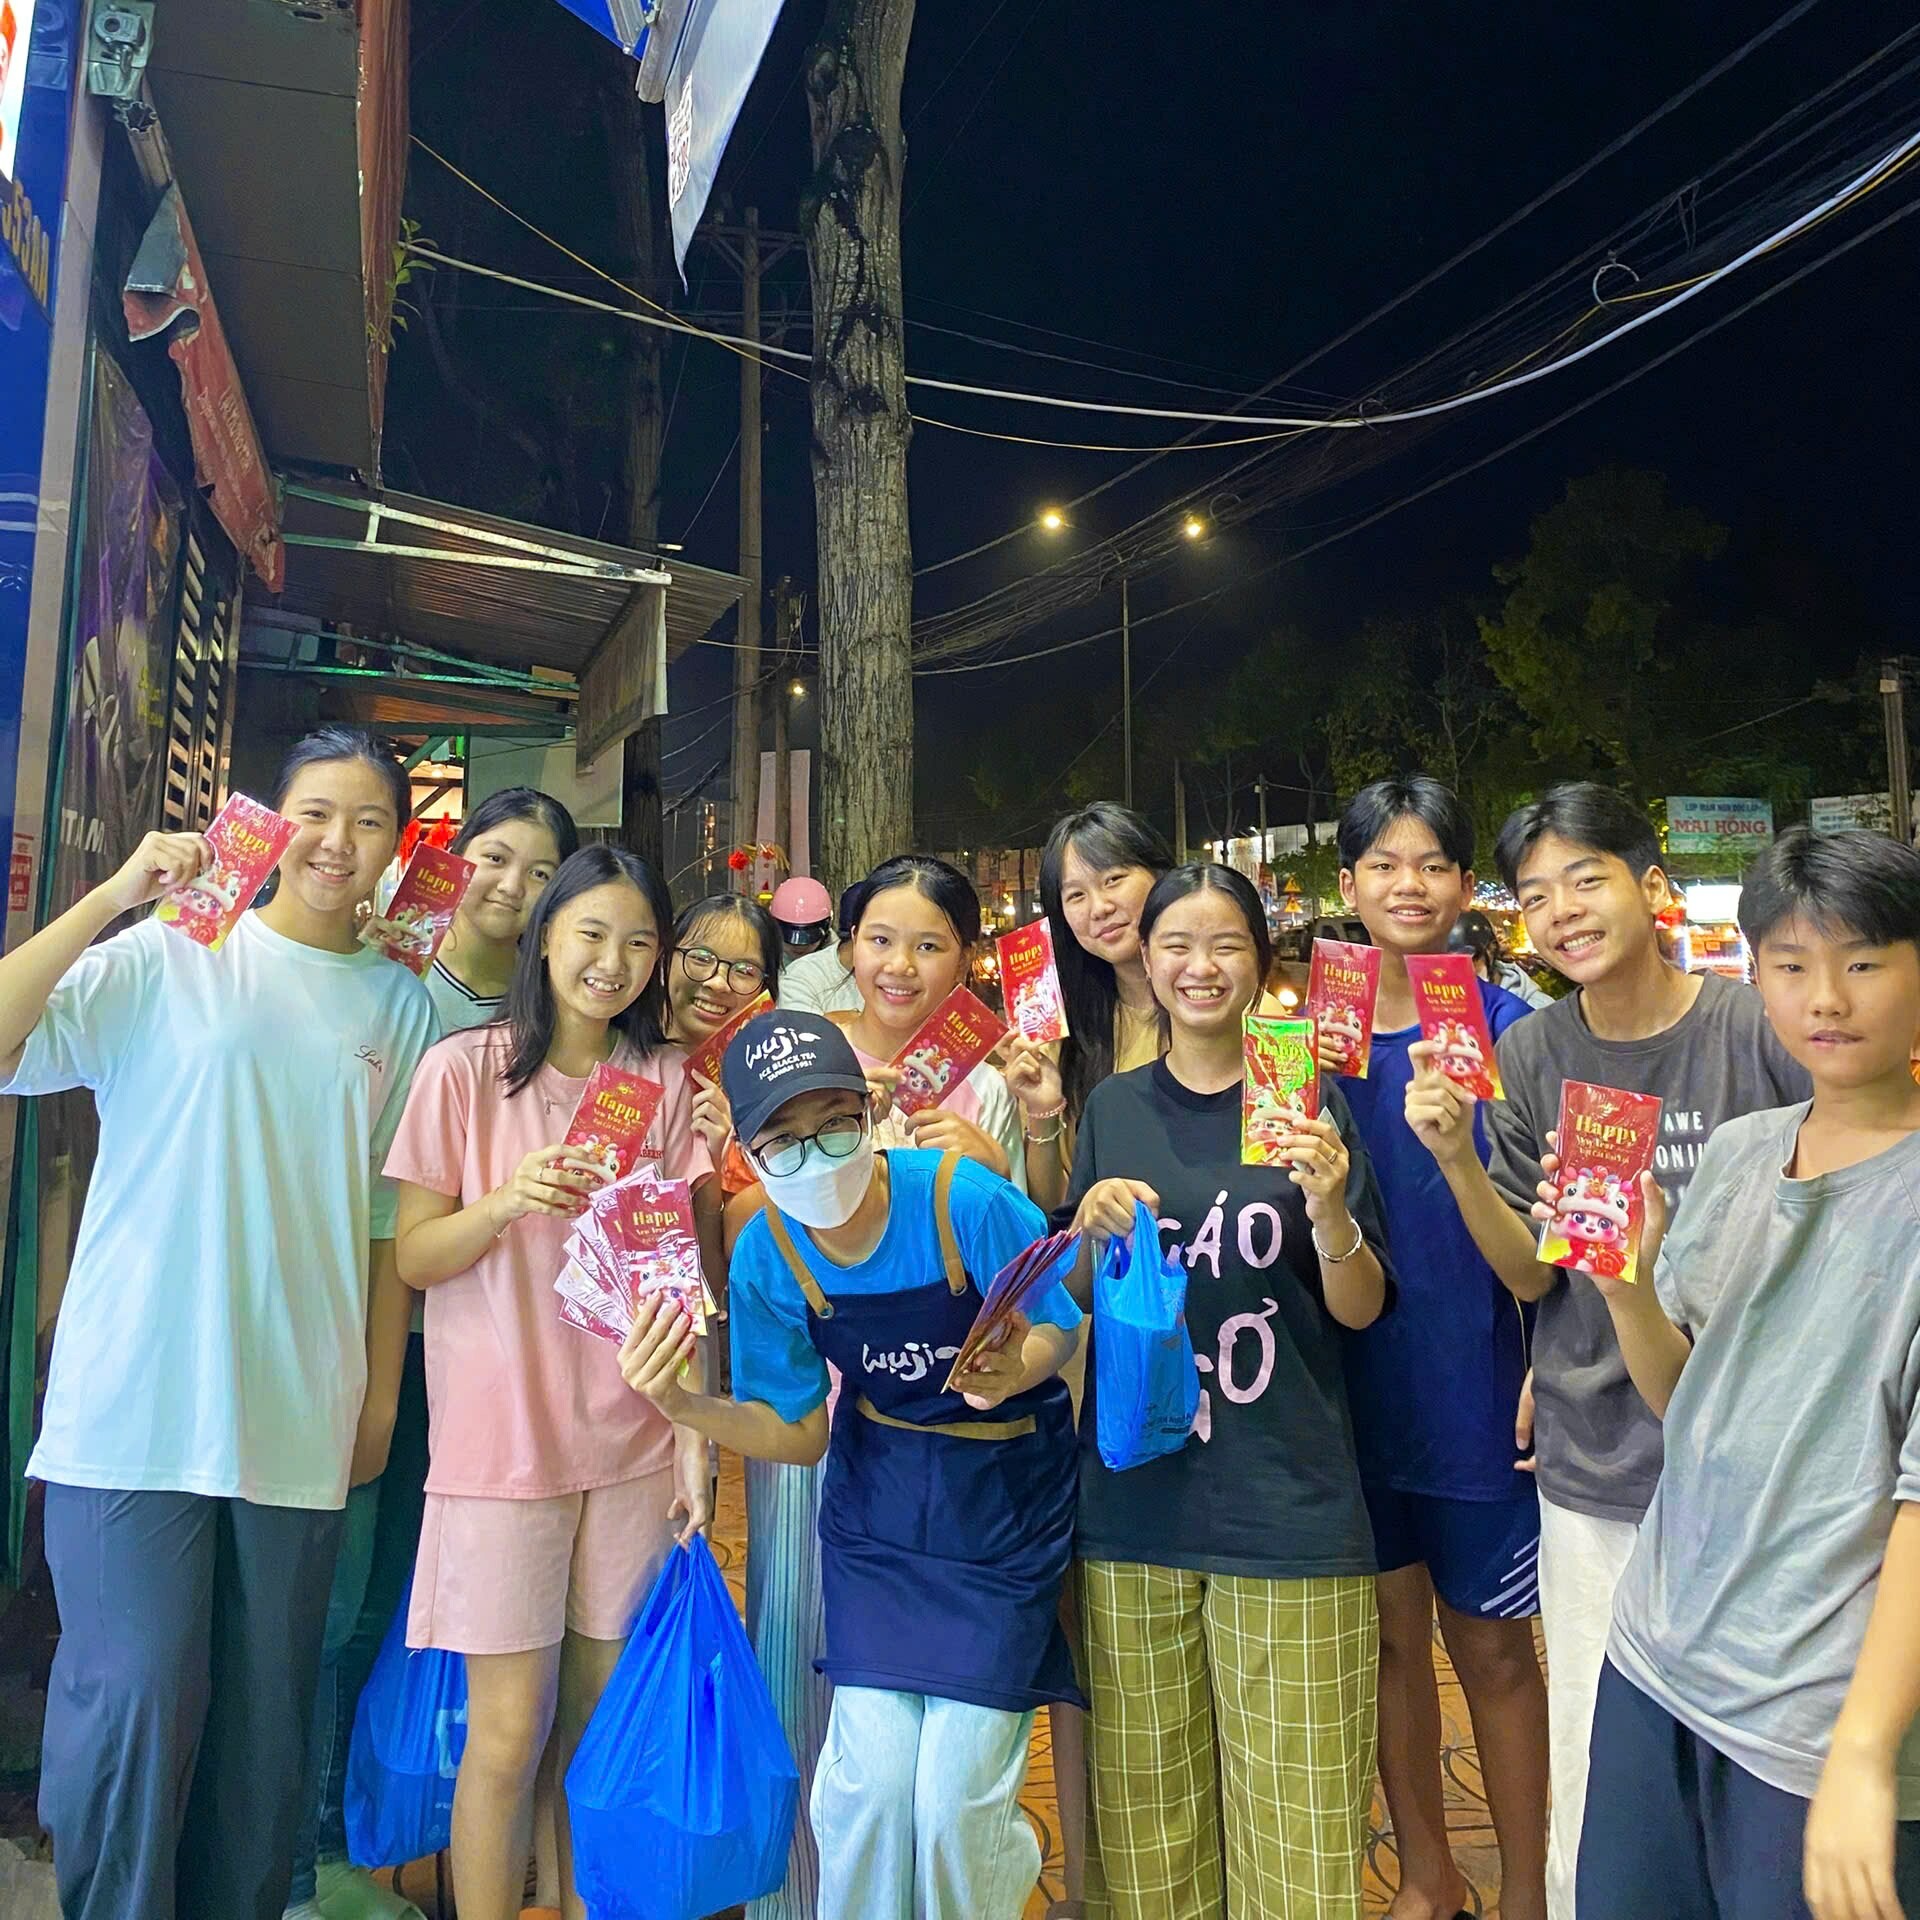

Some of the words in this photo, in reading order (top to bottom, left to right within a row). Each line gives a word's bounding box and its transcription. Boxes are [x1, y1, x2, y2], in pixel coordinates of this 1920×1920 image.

[230, 820, 272, 854] Happy
[417, 867, 455, 894] Happy
[1010, 945, 1042, 965] Happy
[1324, 963, 1367, 985] Happy
[1422, 981, 1466, 1000] Happy
[947, 1010, 982, 1049] Happy
[772, 1054, 801, 1071] BLACK
[800, 1052, 817, 1062] TEA
[596, 1091, 641, 1124] Happy
[1576, 1113, 1637, 1147] Happy
[632, 1211, 679, 1227] Happy
